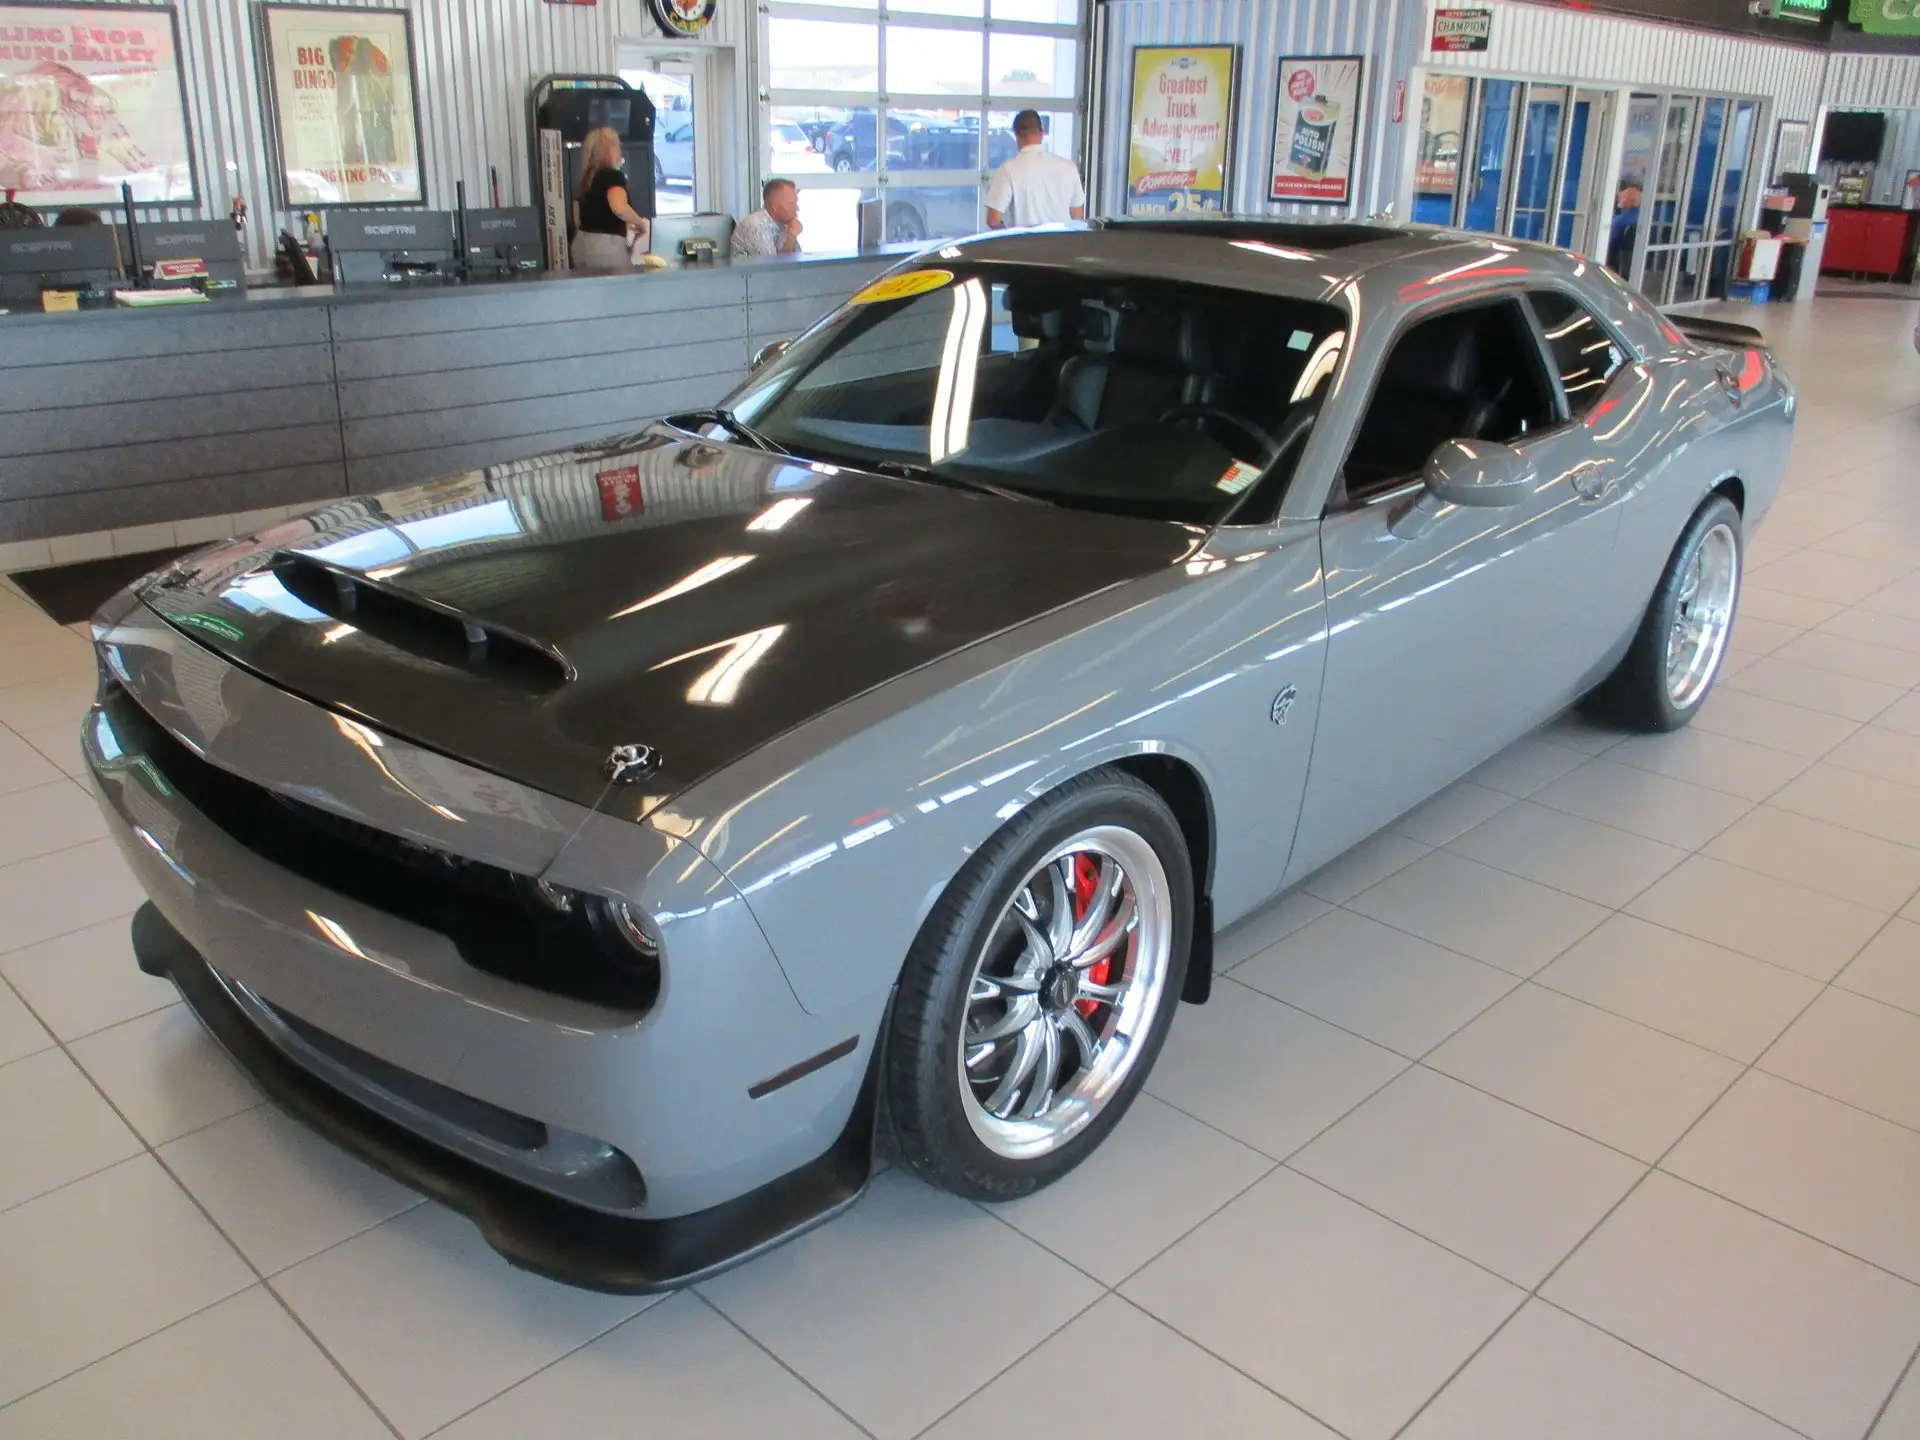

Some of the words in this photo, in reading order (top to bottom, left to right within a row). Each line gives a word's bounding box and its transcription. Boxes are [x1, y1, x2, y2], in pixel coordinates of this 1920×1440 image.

[1437, 20, 1487, 33] CHAMPION
[296, 46, 325, 66] BIG
[293, 69, 337, 90] BINGO
[1159, 73, 1209, 96] Greatest
[1167, 96, 1198, 119] Truck
[1141, 117, 1221, 142] Advancement
[1302, 127, 1320, 139] AUTO
[1294, 132, 1325, 153] POLISH
[304, 167, 367, 183] NGLING
[369, 167, 403, 183] BRS
